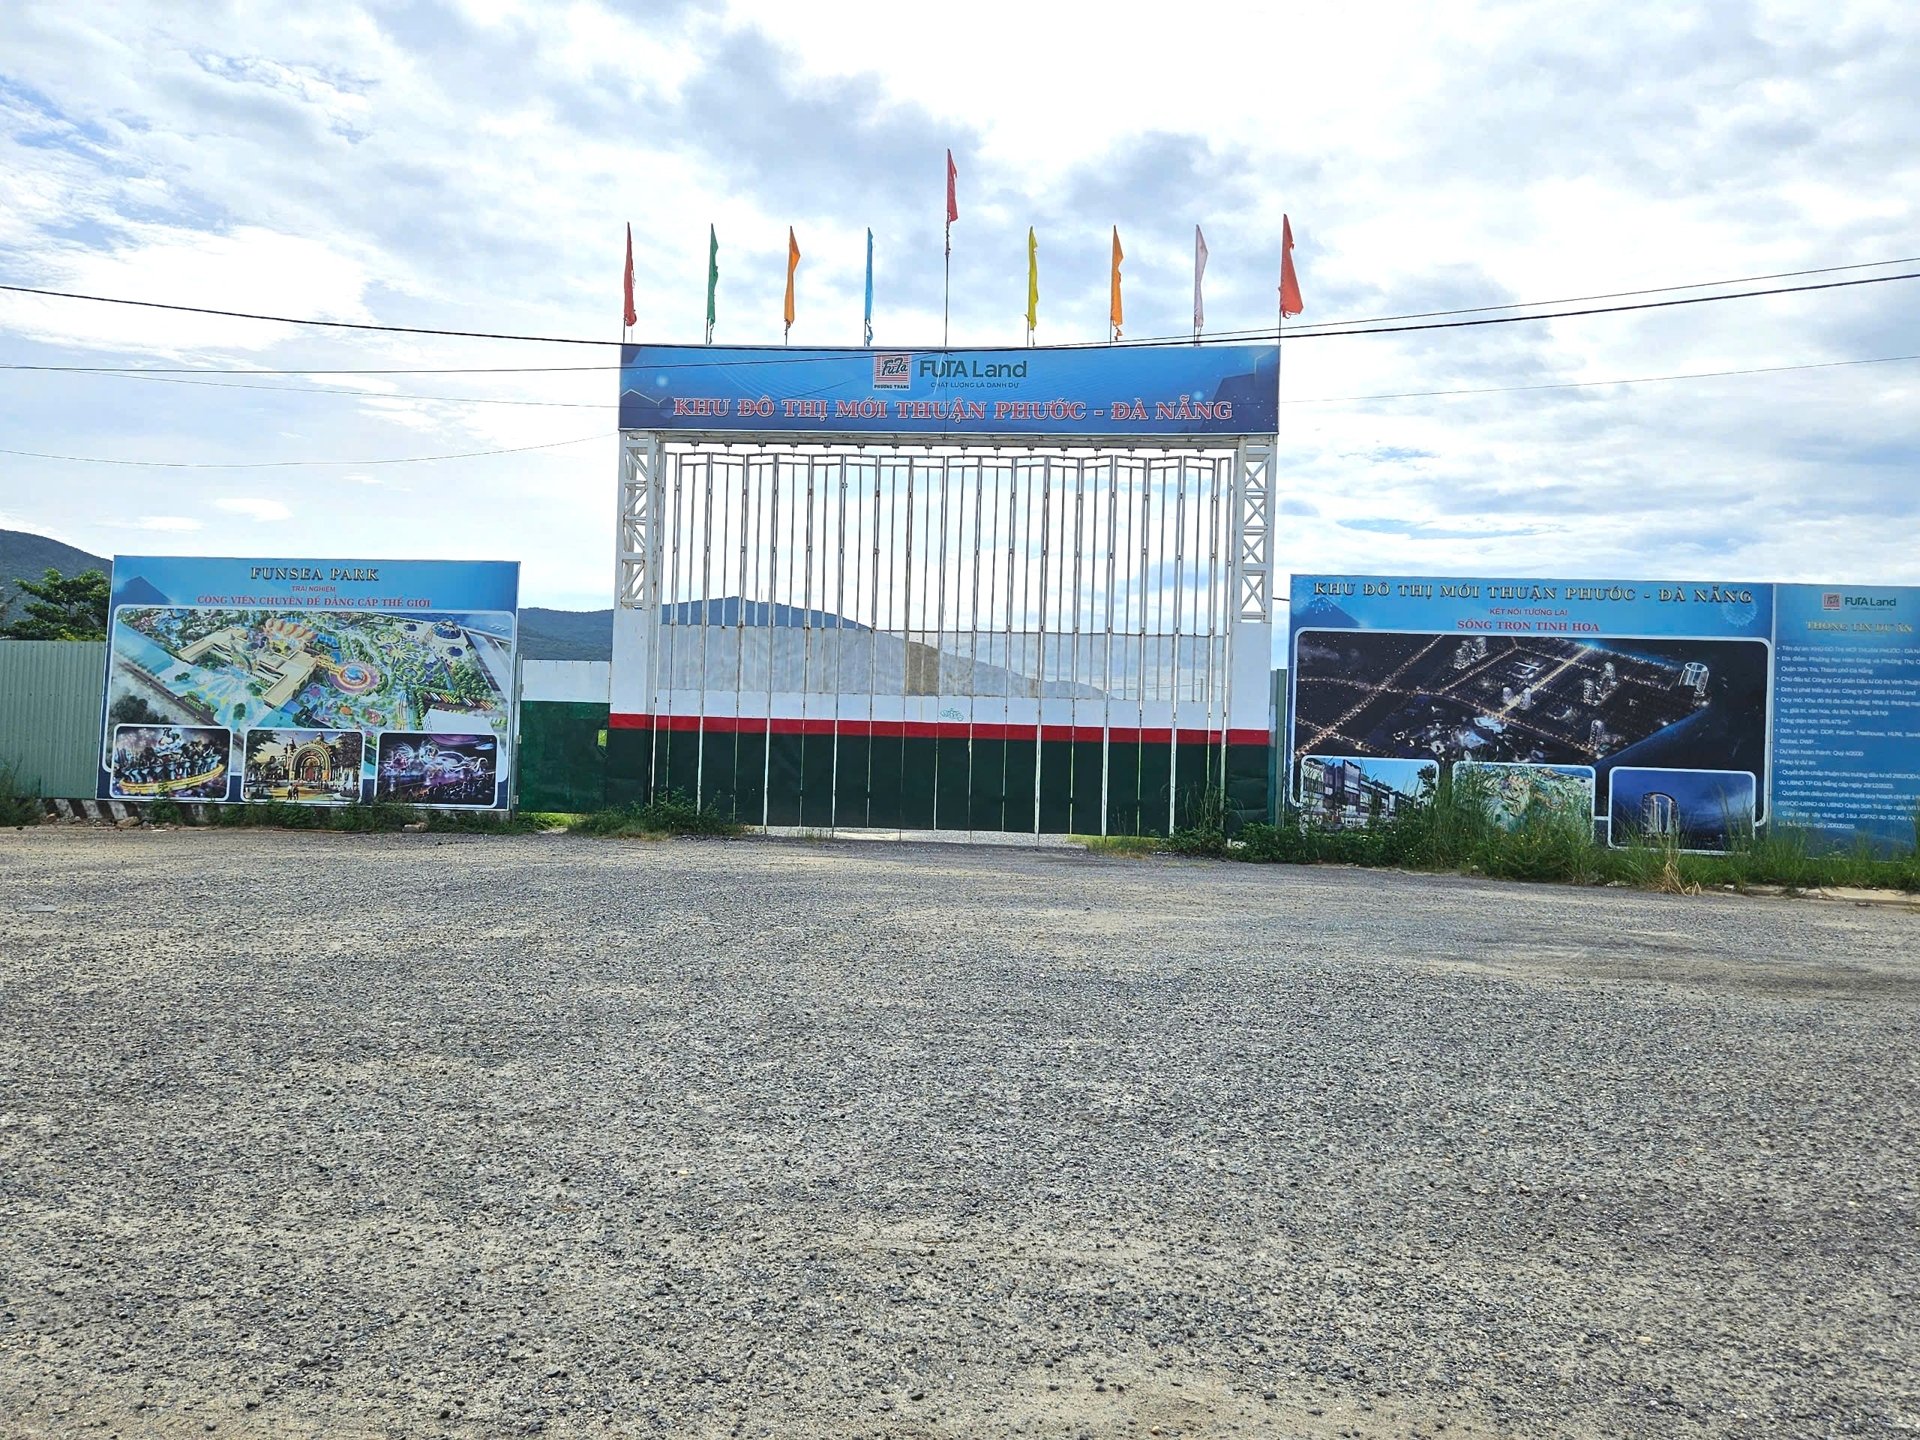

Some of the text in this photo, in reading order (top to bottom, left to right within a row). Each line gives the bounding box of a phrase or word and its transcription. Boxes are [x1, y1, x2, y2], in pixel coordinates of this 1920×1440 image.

[920, 360, 1027, 378] FUTA Land
[673, 397, 731, 416] KHU
[738, 395, 775, 417] ĐÔ
[782, 399, 828, 422] THỊ
[835, 396, 888, 419] MỚI
[896, 397, 986, 423] THUẬN
[994, 398, 1086, 421] PHƯỚC
[1112, 398, 1149, 420] ĐÀ
[1155, 395, 1233, 420] NẴNG
[250, 567, 380, 582] FUNSEA PARK
[258, 595, 303, 606] CHUYÊN
[1314, 582, 1356, 596] KHU
[1363, 582, 1391, 597] ĐÔ
[1398, 584, 1434, 600] THỊ
[1440, 584, 1481, 599] MỚI
[1488, 585, 1558, 602] THUẬN
[1566, 586, 1637, 601] PHƯỚC
[1659, 586, 1687, 602] ĐÀ
[1694, 586, 1753, 604] NẴNG
[1844, 596, 1897, 606] FUTA Land
[1458, 618, 1600, 632] SỐNG TRỌN TINH HOA
